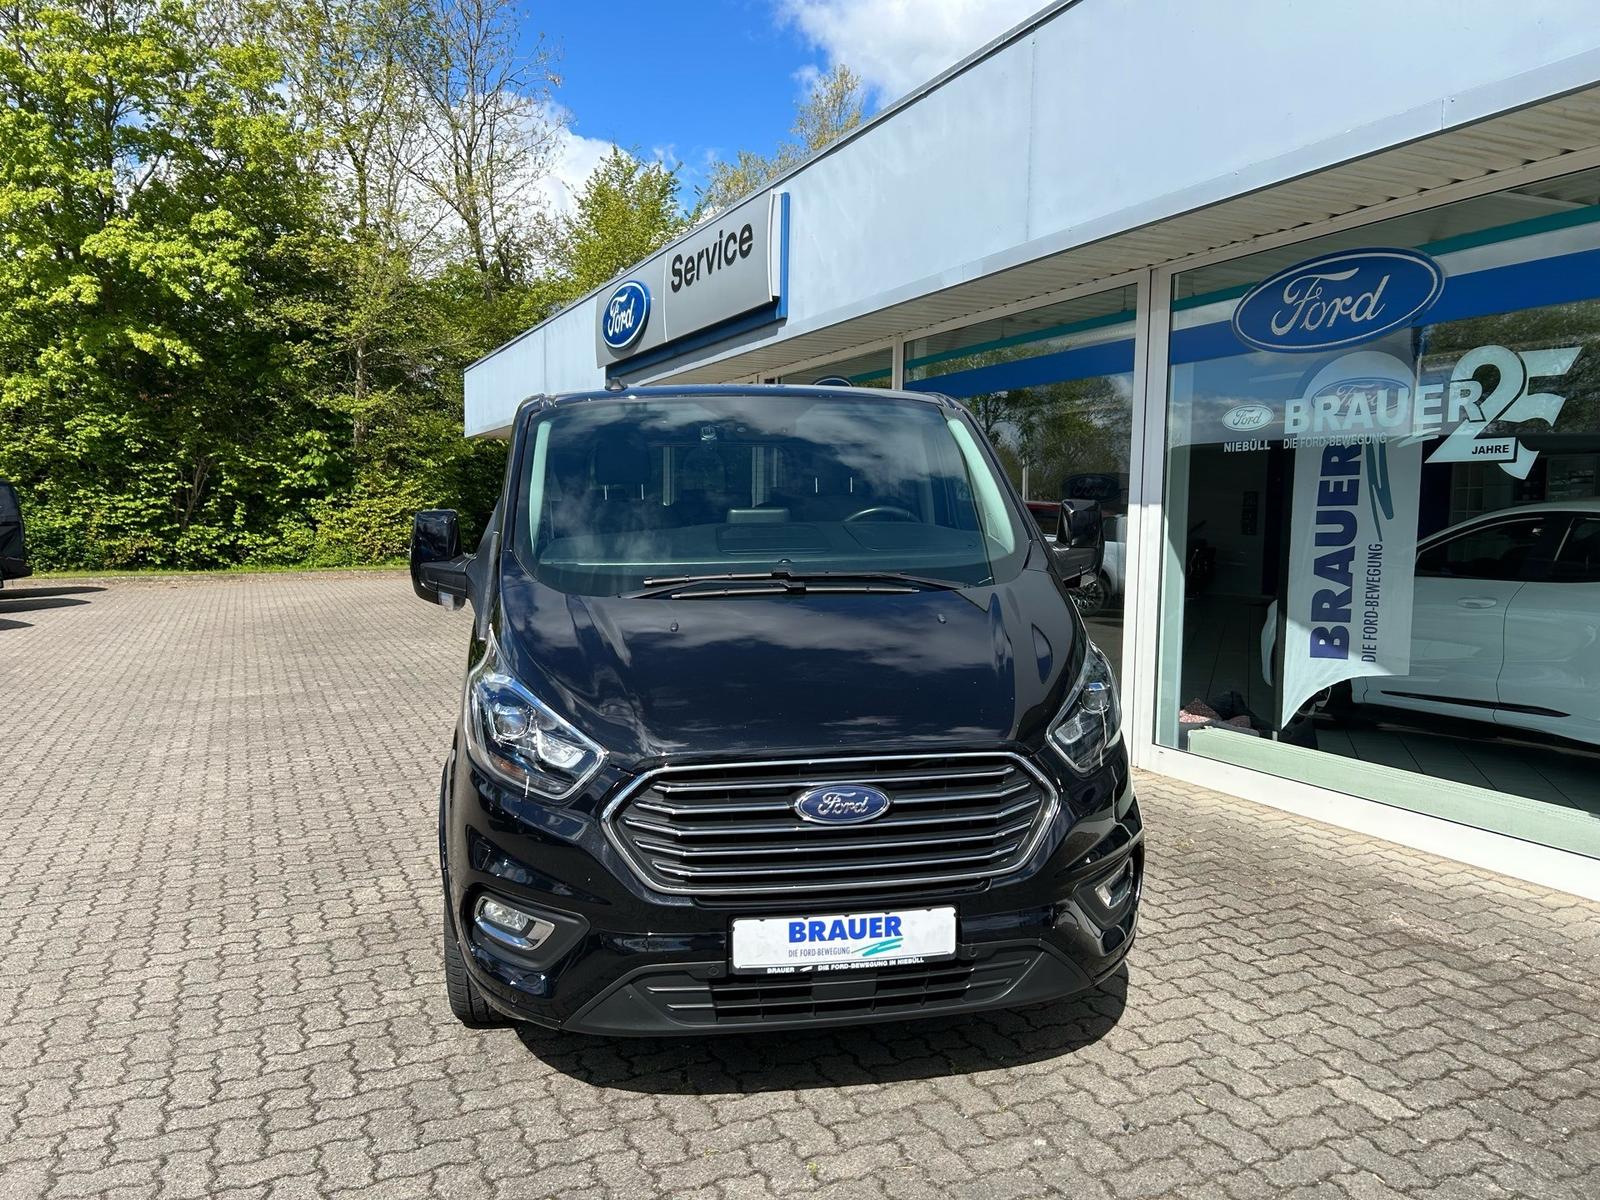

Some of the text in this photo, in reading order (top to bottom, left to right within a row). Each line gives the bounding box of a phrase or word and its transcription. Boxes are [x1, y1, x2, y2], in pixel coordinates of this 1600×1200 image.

[671, 223, 754, 293] Service
[1270, 267, 1390, 337] Ford
[607, 294, 635, 337] Ford
[1232, 409, 1263, 426] Ford
[1284, 380, 1486, 435] BRAUER
[1223, 438, 1271, 453] NIEBÜLL
[1283, 436, 1298, 450] DIE
[1471, 443, 1510, 455] JAHRE
[1309, 442, 1362, 660] BRAUER
[1361, 542, 1384, 663] DIE FORD-BEWEGUNG
[818, 791, 870, 815] Ford
[788, 915, 904, 943] BRAUER
[788, 946, 851, 957] DIE FORD-BEWEGUNG
[767, 966, 795, 974] BRAUER
[831, 961, 888, 971] FORD-BEWEGUNG
